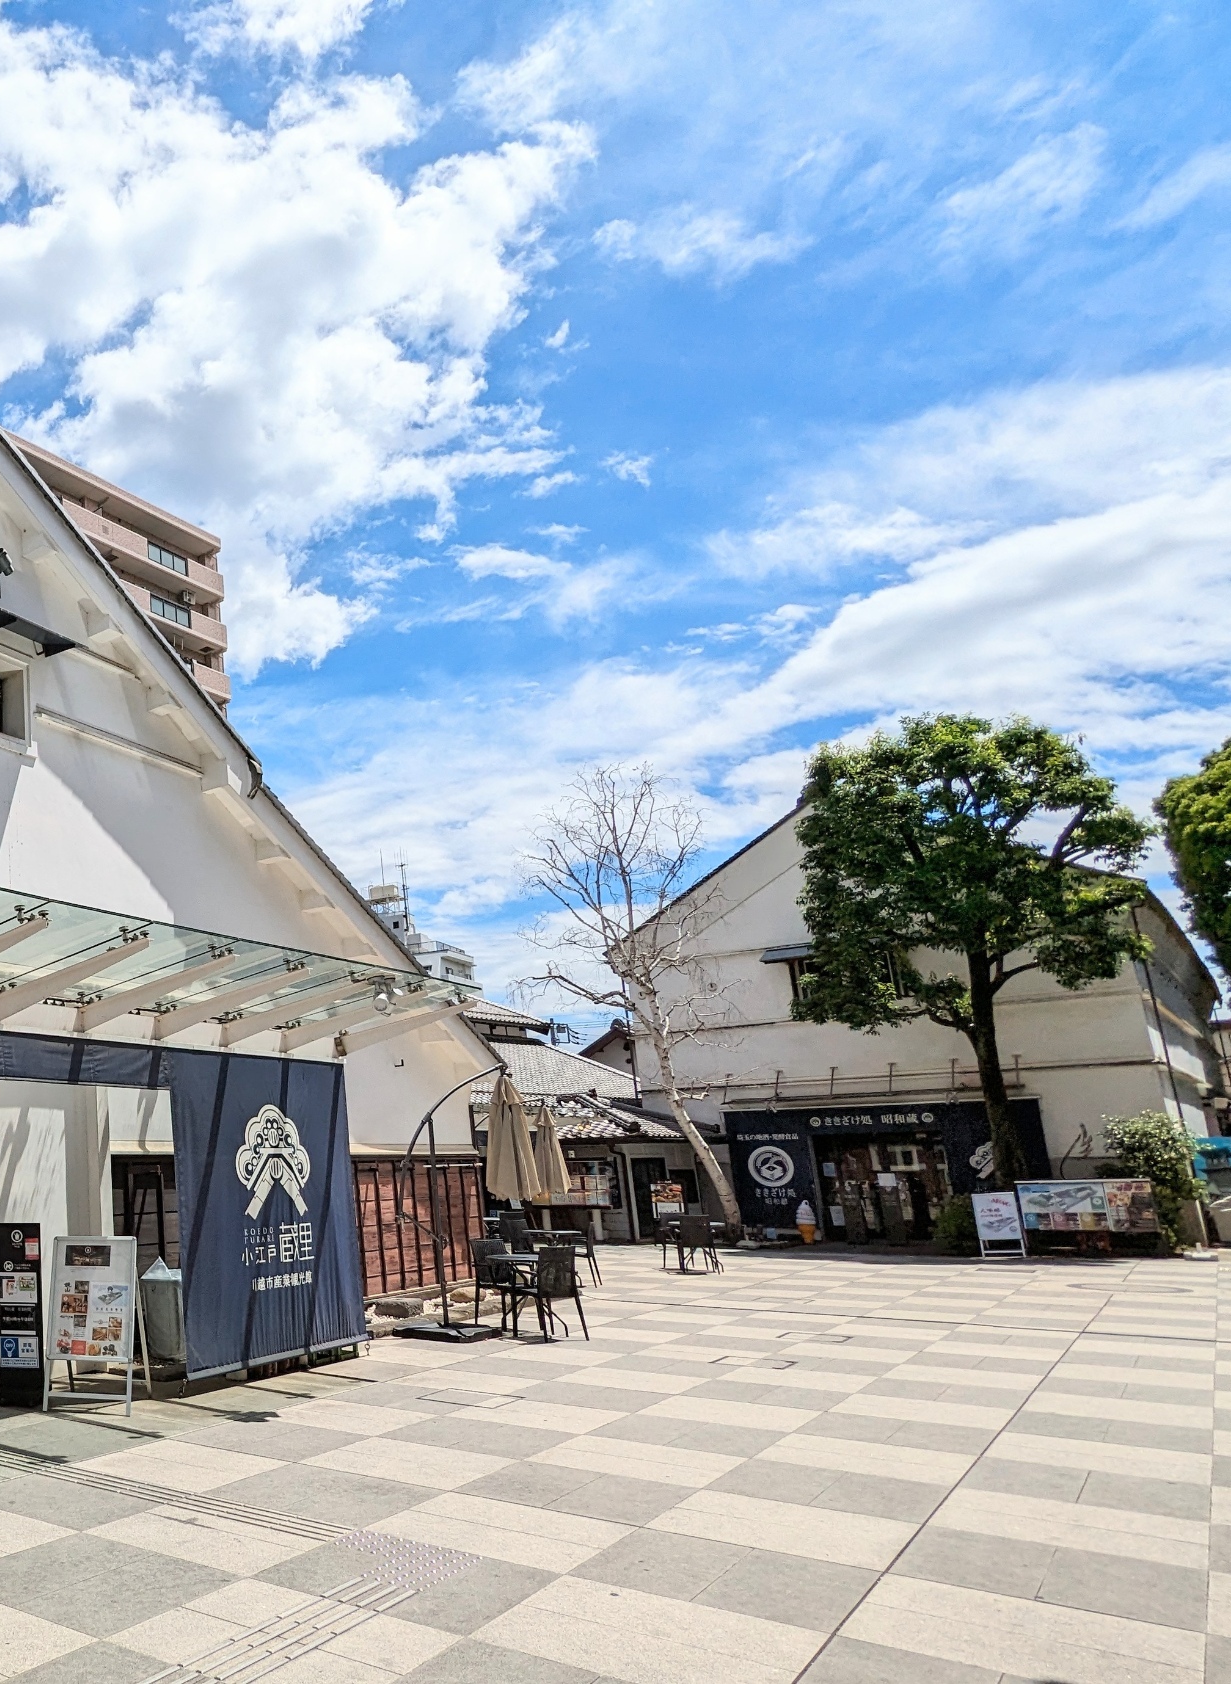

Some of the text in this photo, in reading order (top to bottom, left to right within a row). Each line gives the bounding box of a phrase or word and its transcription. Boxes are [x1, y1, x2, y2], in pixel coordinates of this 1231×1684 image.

[824, 1112, 919, 1126] ききざけ処 昭和蔵
[754, 1187, 797, 1198] ききざけ処
[244, 1226, 274, 1236] KOEDO
